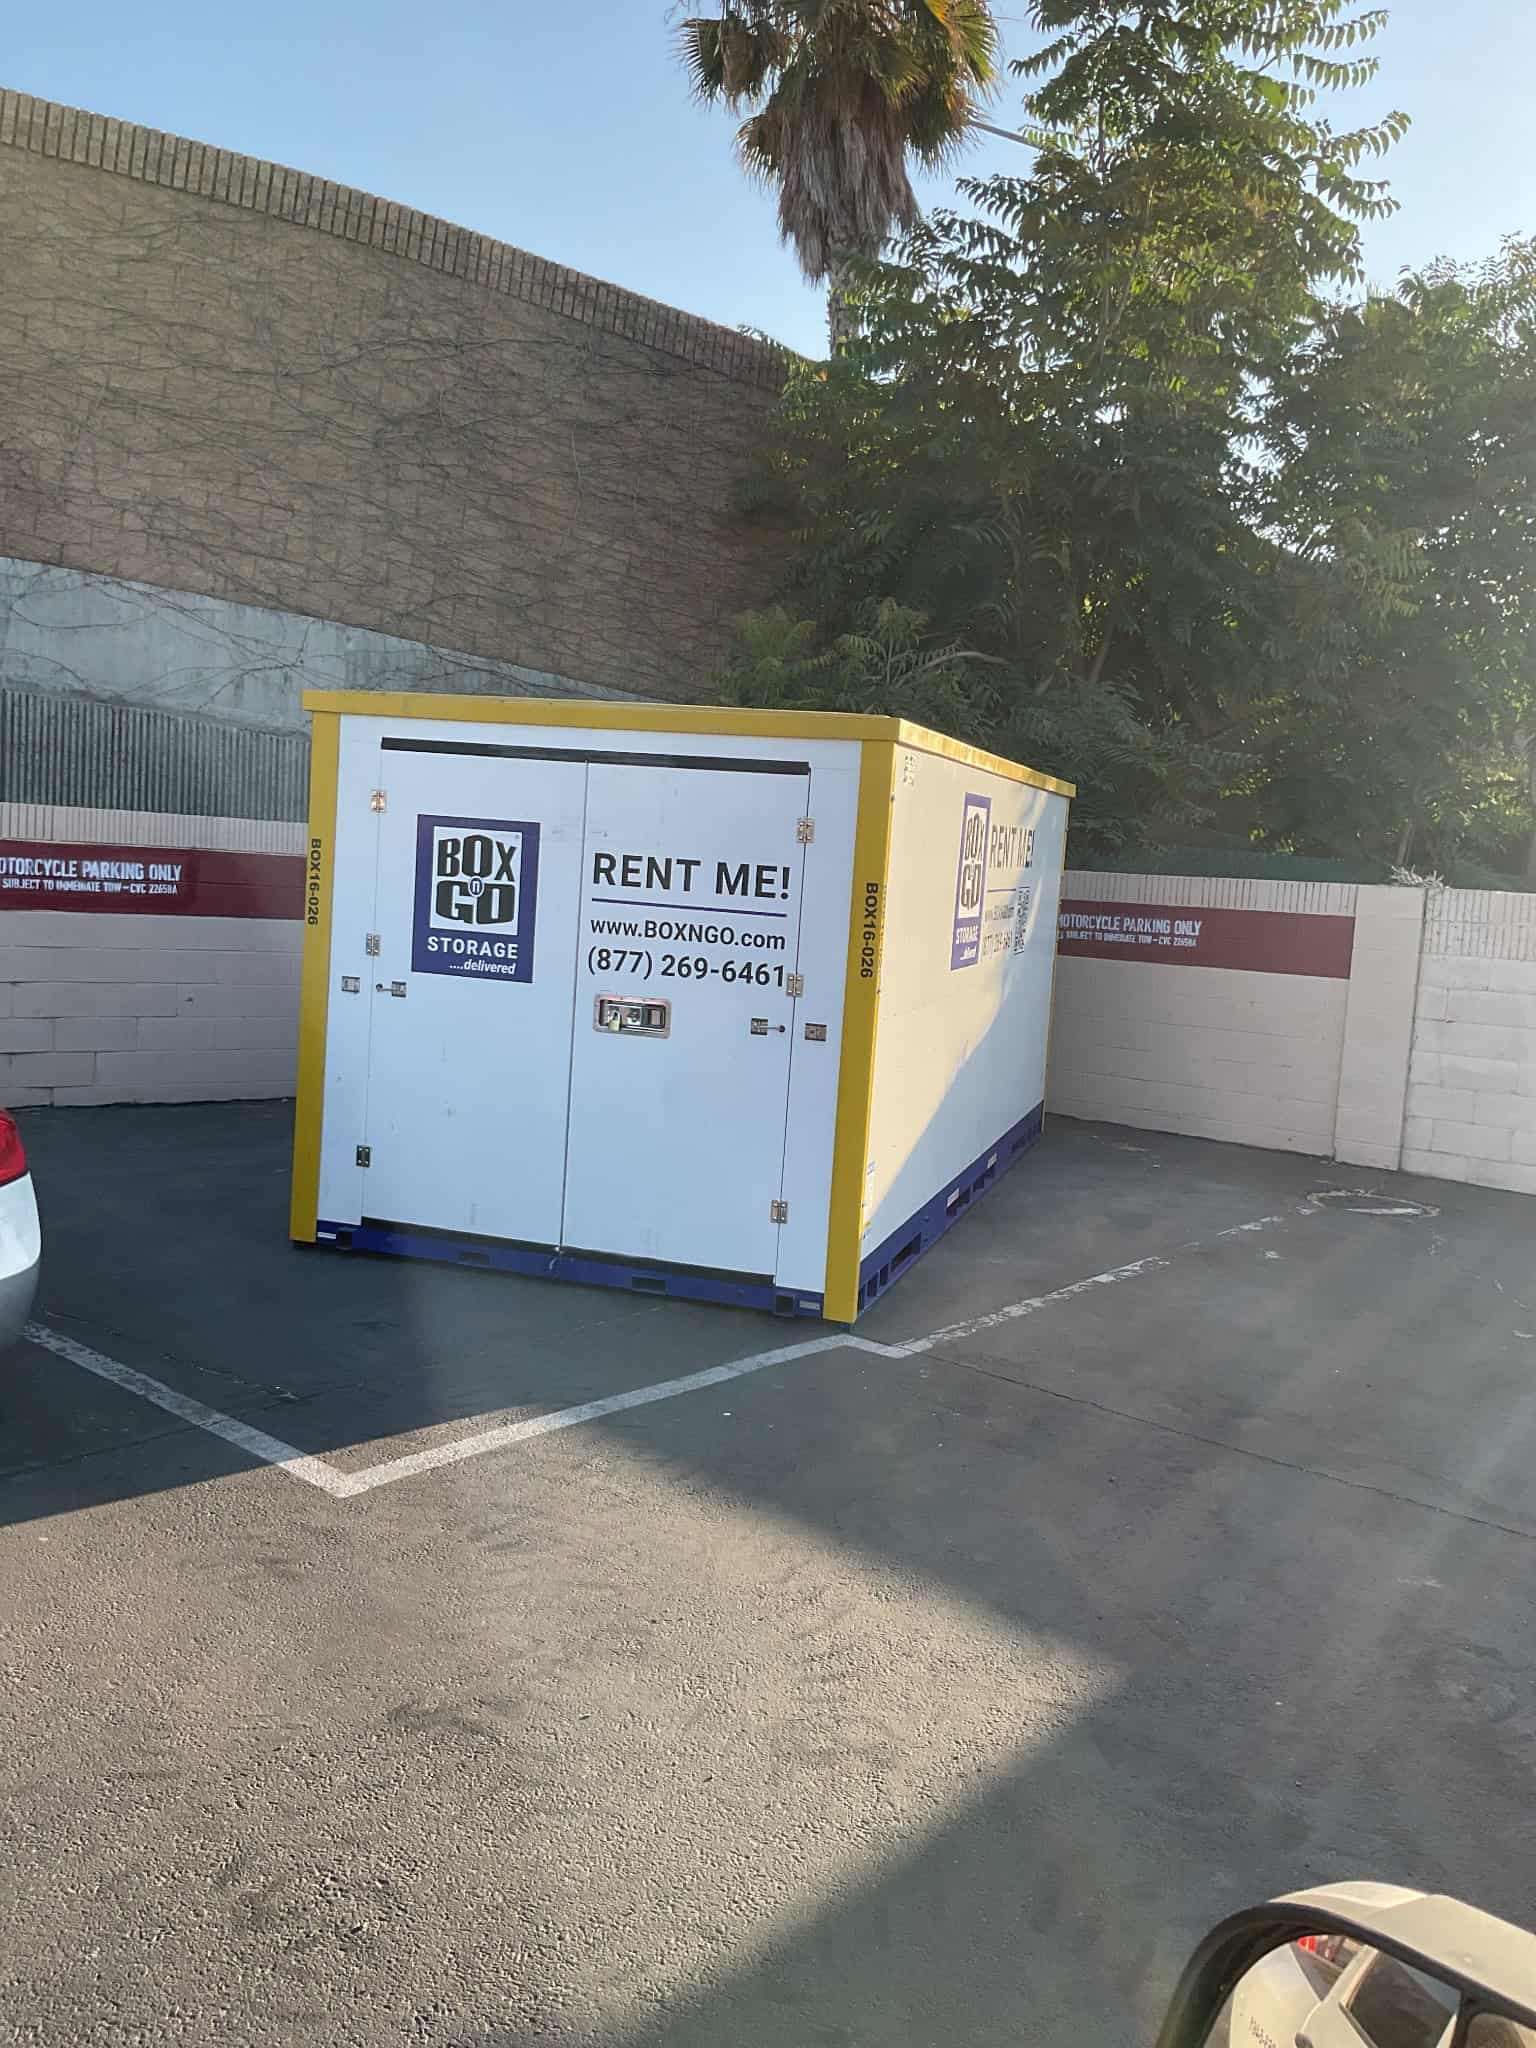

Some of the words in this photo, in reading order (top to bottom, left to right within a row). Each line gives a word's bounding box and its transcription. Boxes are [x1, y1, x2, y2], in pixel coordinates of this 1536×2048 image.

[437, 834, 517, 881] BOX
[964, 813, 985, 861] BOX
[989, 824, 1017, 869] RENT
[1017, 827, 1035, 869] ME!
[0, 856, 78, 878] OTORCYCLE
[82, 860, 144, 880] PARKING
[149, 863, 182, 882] ONLY
[308, 838, 321, 926] BOX16-026
[592, 852, 701, 892] RENT
[715, 861, 791, 900] ME!
[960, 863, 982, 911] GO
[436, 879, 516, 925] GO
[427, 936, 519, 959] STORAGE
[591, 919, 786, 950] www.BOXNGO.com
[861, 882, 879, 979] BOX16-026
[1123, 918, 1170, 934] PARKING
[1174, 920, 1202, 936] ONLY
[588, 945, 653, 980] (877)
[661, 954, 785, 987] 269-6461
